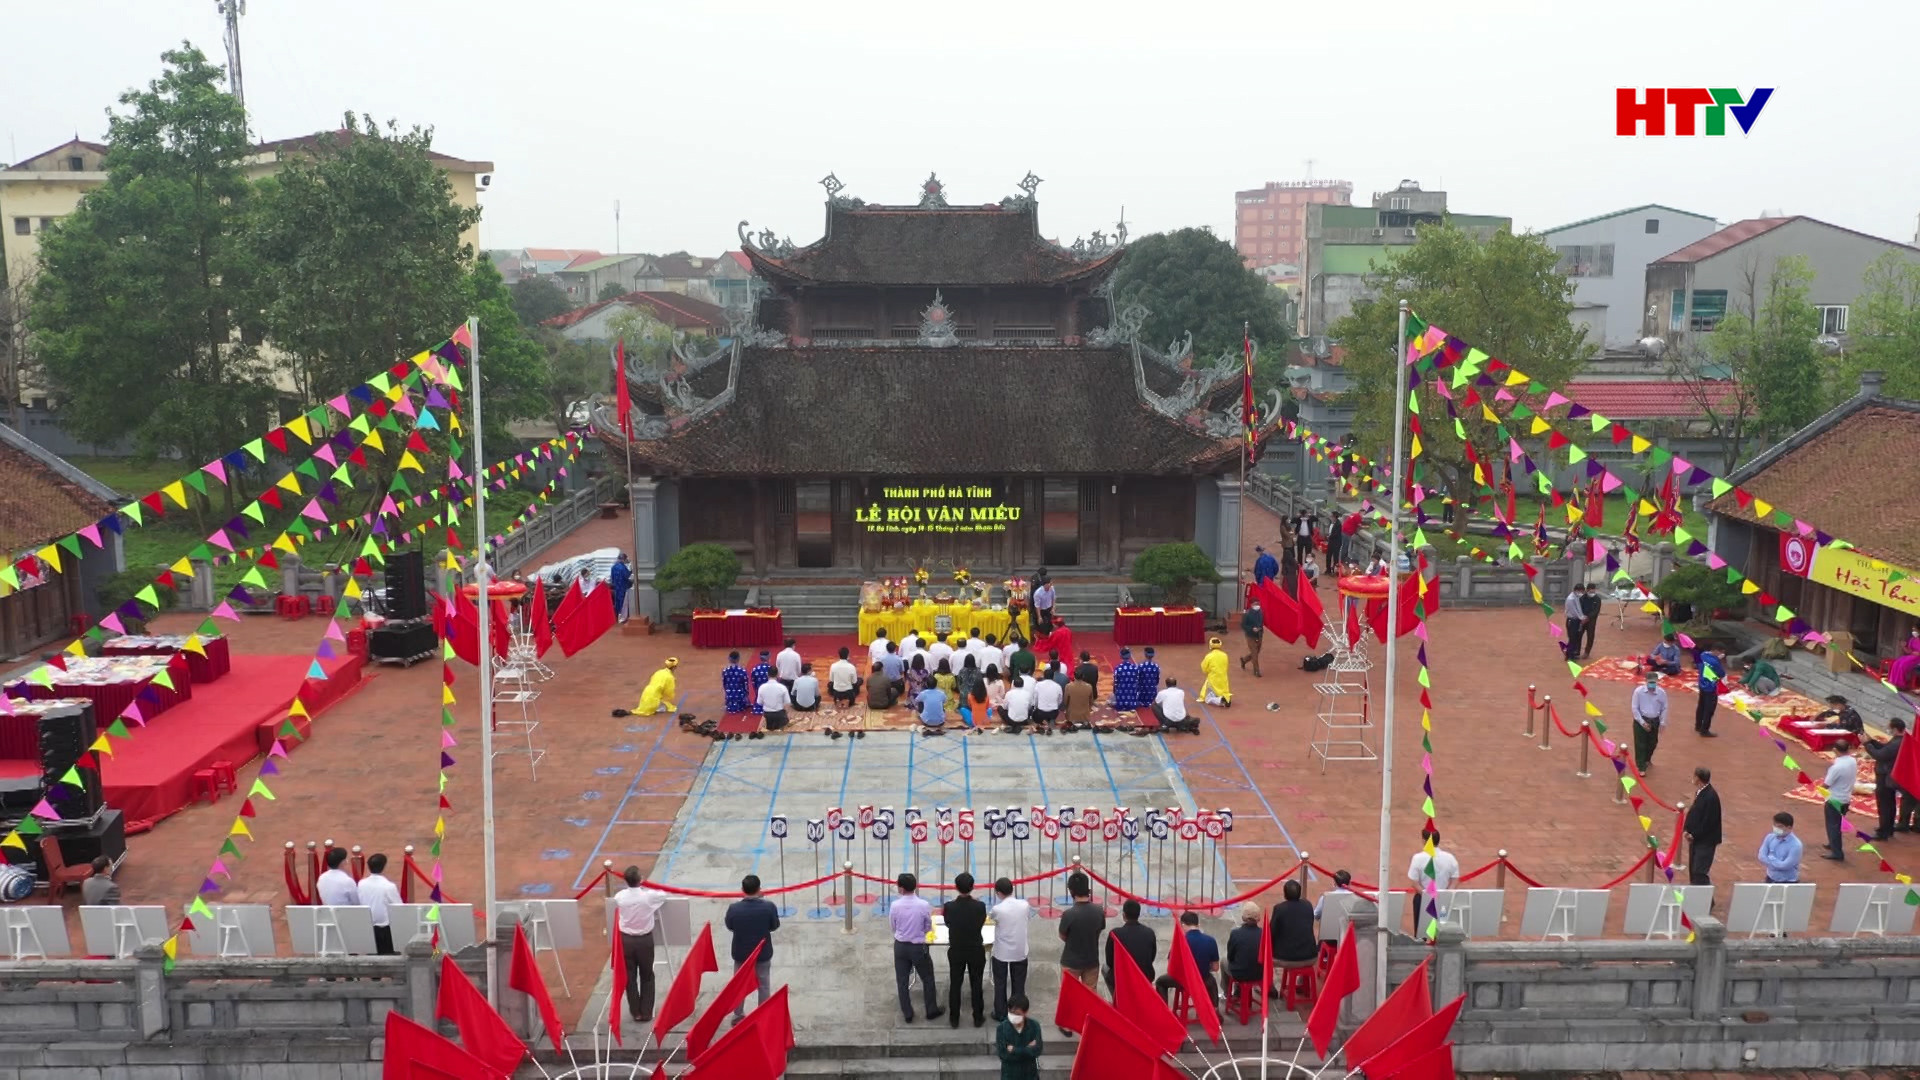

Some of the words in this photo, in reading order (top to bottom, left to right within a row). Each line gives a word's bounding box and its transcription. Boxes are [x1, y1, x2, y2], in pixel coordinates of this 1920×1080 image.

[883, 486, 919, 498] THÀNH
[923, 484, 945, 498] PHỐ
[948, 486, 963, 498] HÀ
[966, 485, 992, 498] TĨNH
[855, 502, 881, 522] LỄ
[887, 505, 921, 524] HỘI
[926, 505, 965, 522] VĂN
[970, 502, 1021, 521] MIẾU
